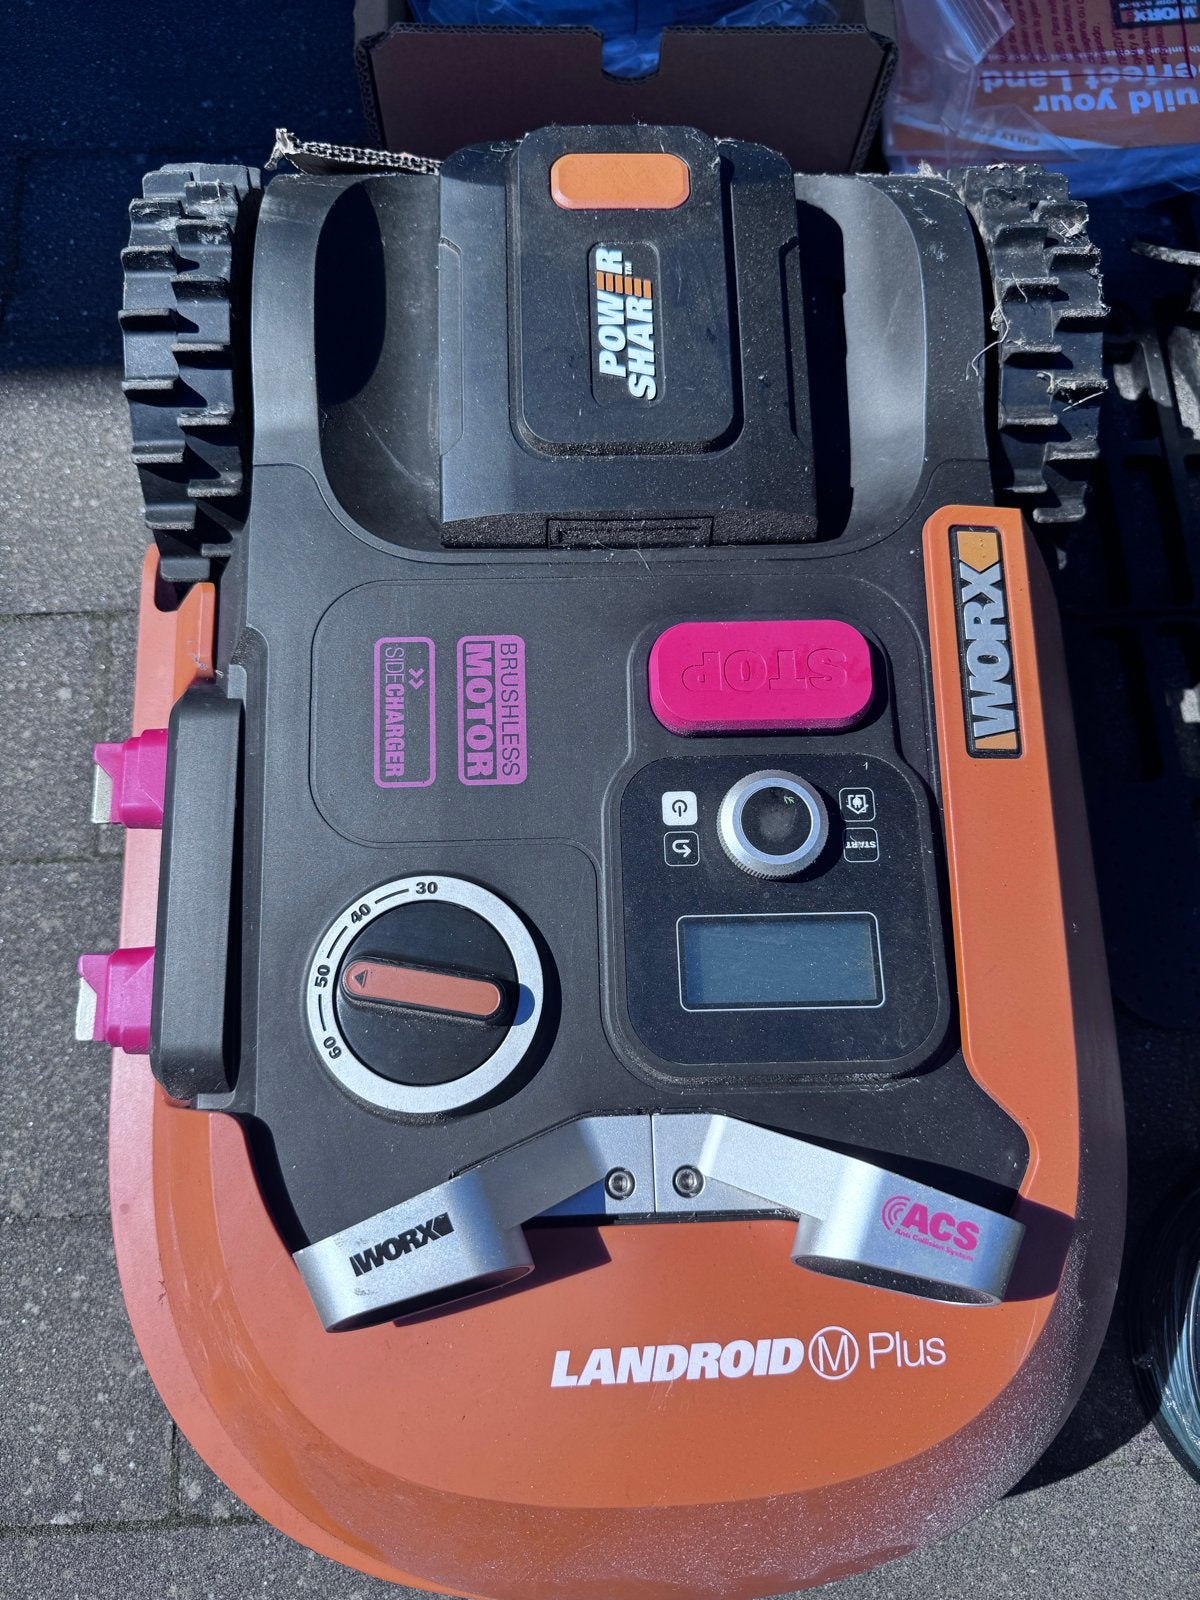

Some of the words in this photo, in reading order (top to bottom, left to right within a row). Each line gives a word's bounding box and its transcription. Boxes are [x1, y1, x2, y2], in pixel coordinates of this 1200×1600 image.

[1134, 6, 1198, 22] WORX
[978, 69, 1073, 94] Land
[1083, 62, 1200, 90] erfect
[1033, 87, 1118, 113] your
[595, 248, 626, 377] POWER
[625, 275, 657, 401] SHARE
[959, 561, 1016, 738] WORX
[681, 648, 848, 692] STOP
[385, 647, 405, 777] SIDECHARGER
[465, 643, 494, 777] MOTOR
[500, 643, 521, 776] BRUSHLESS
[845, 840, 877, 849] START
[415, 881, 439, 895] 30
[350, 903, 372, 924] 40
[314, 964, 331, 988] 50
[323, 1036, 343, 1060] 60
[895, 1228, 911, 1239] Anti
[912, 1234, 945, 1252] Collision
[945, 1247, 974, 1262] System
[900, 1202, 980, 1251] ACS
[350, 1217, 441, 1276] WORX
[550, 1337, 805, 1388] LANDROID
[868, 1331, 947, 1369] Plus
